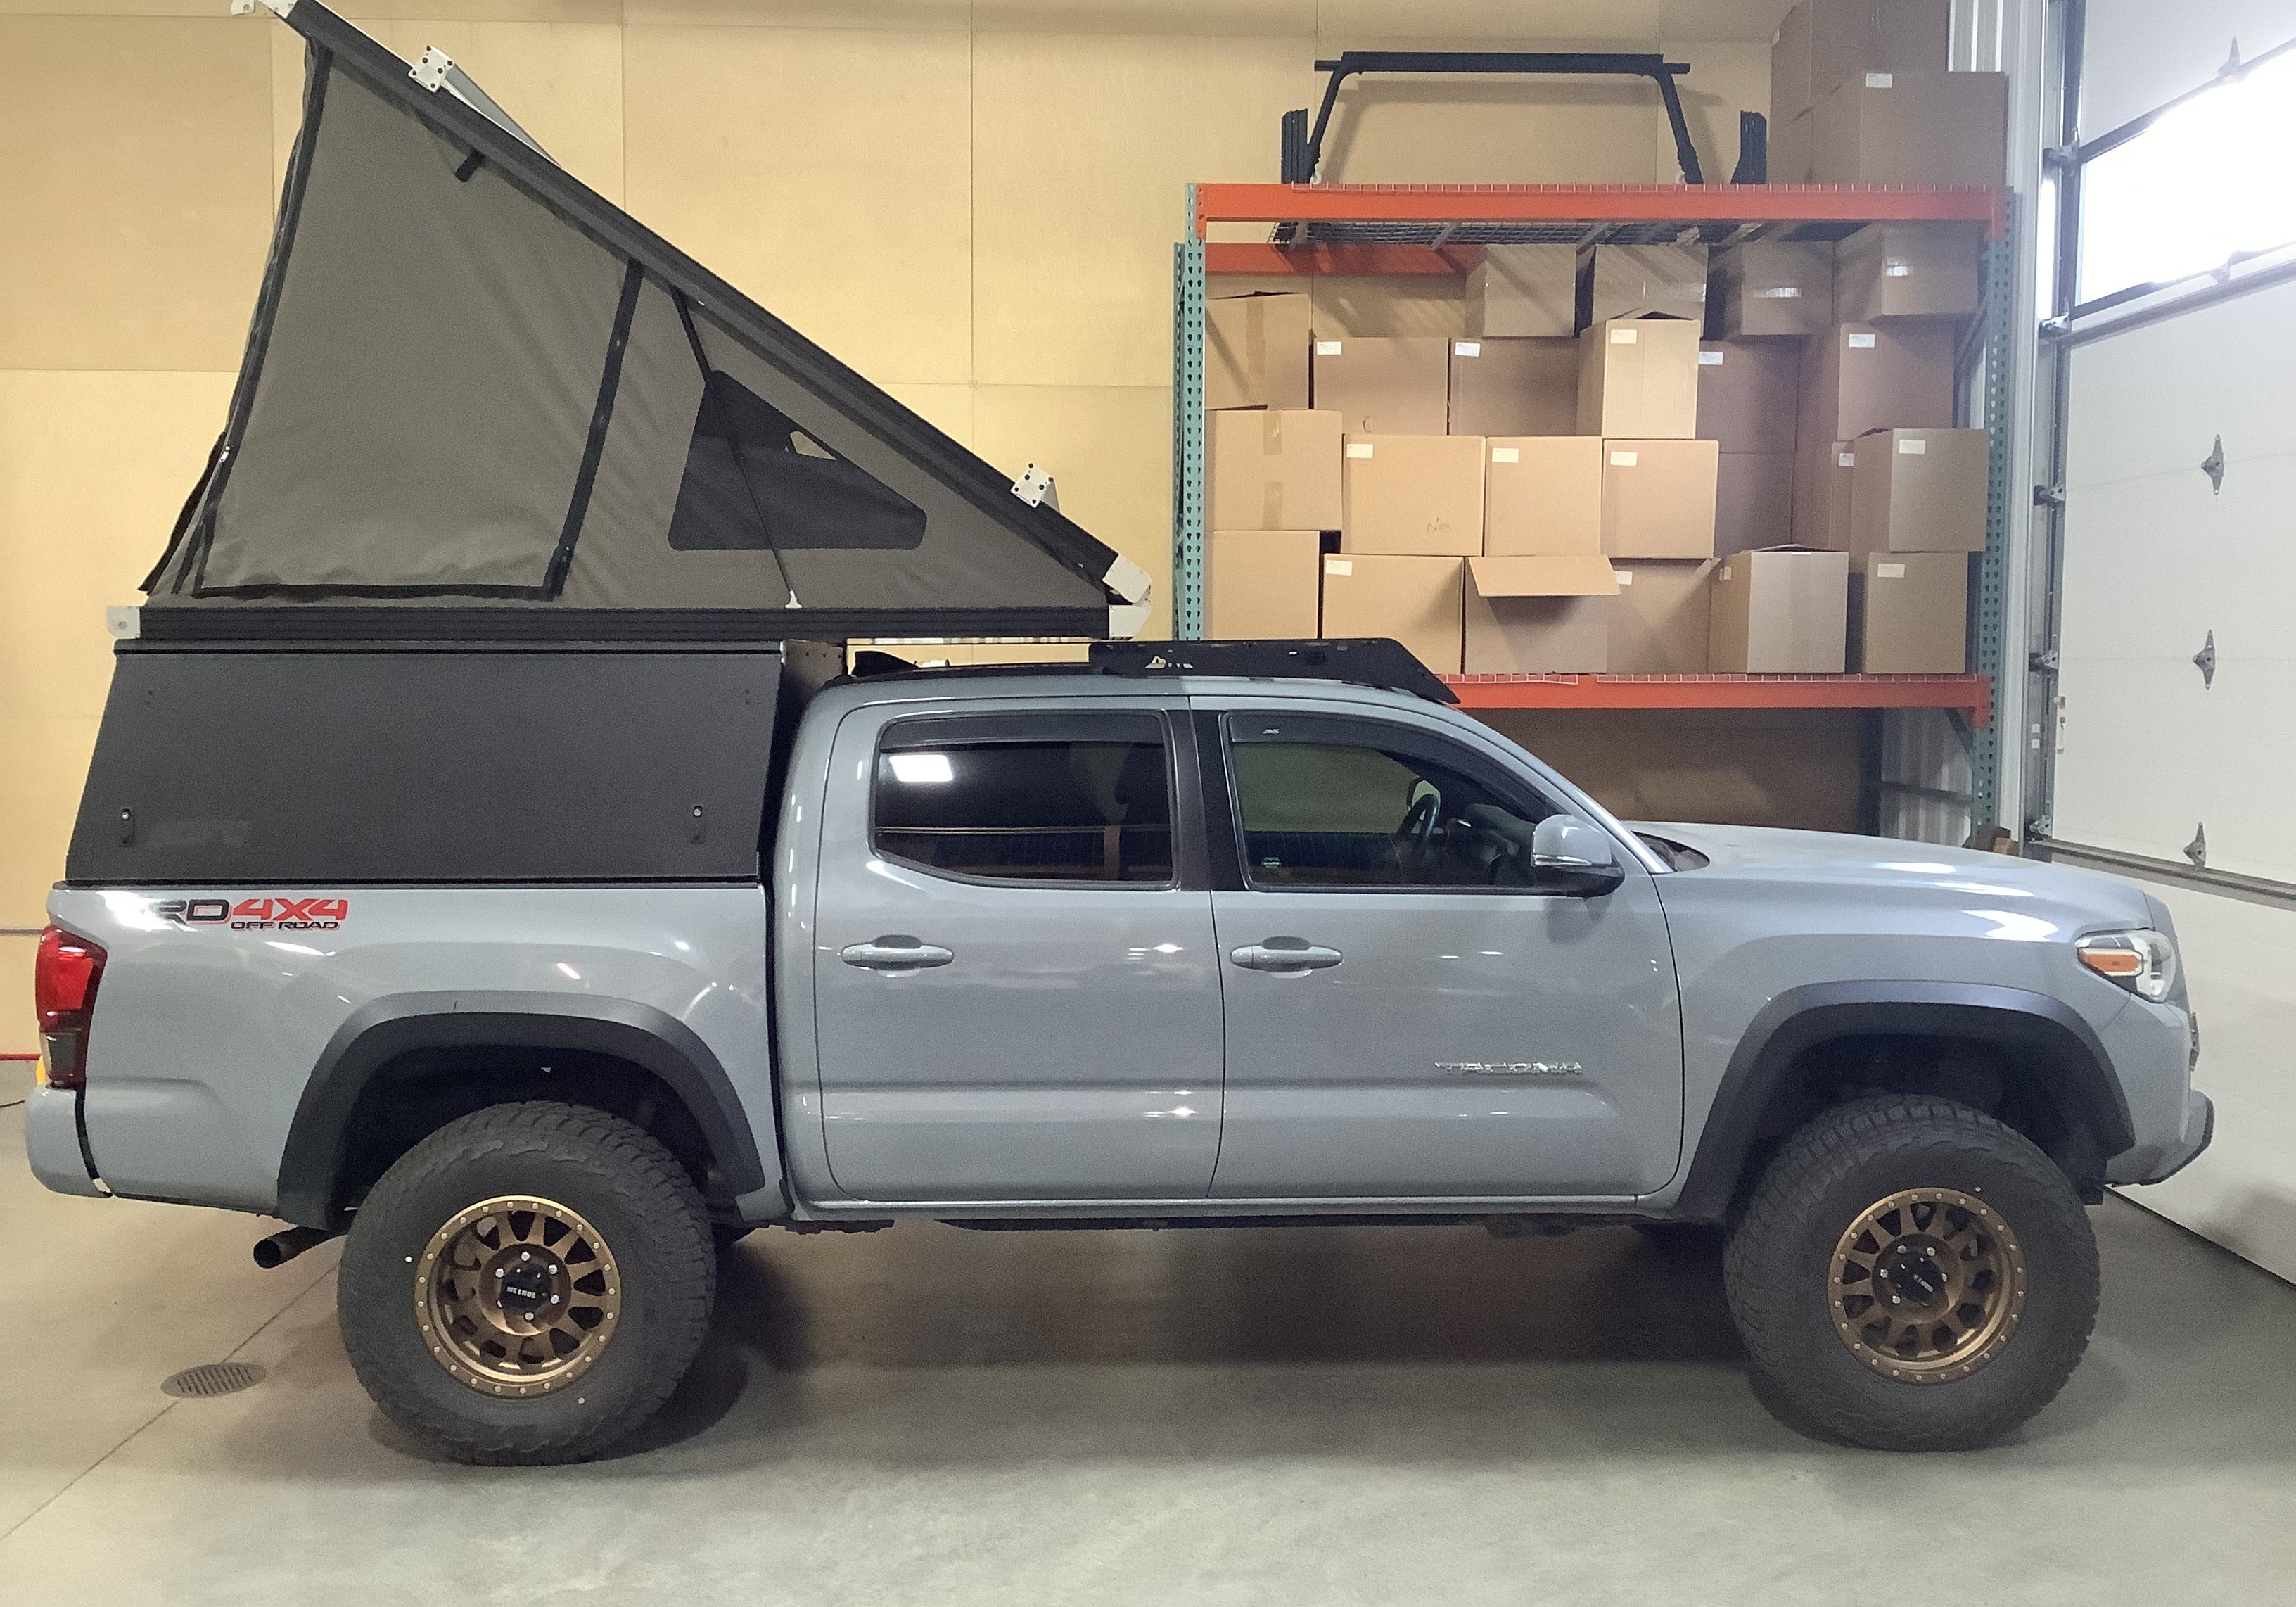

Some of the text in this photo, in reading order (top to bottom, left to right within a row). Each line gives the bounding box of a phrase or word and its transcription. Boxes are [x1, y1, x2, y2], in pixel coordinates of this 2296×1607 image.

[159, 898, 349, 927] RD 4X4
[230, 921, 340, 931] OFF ROAD
